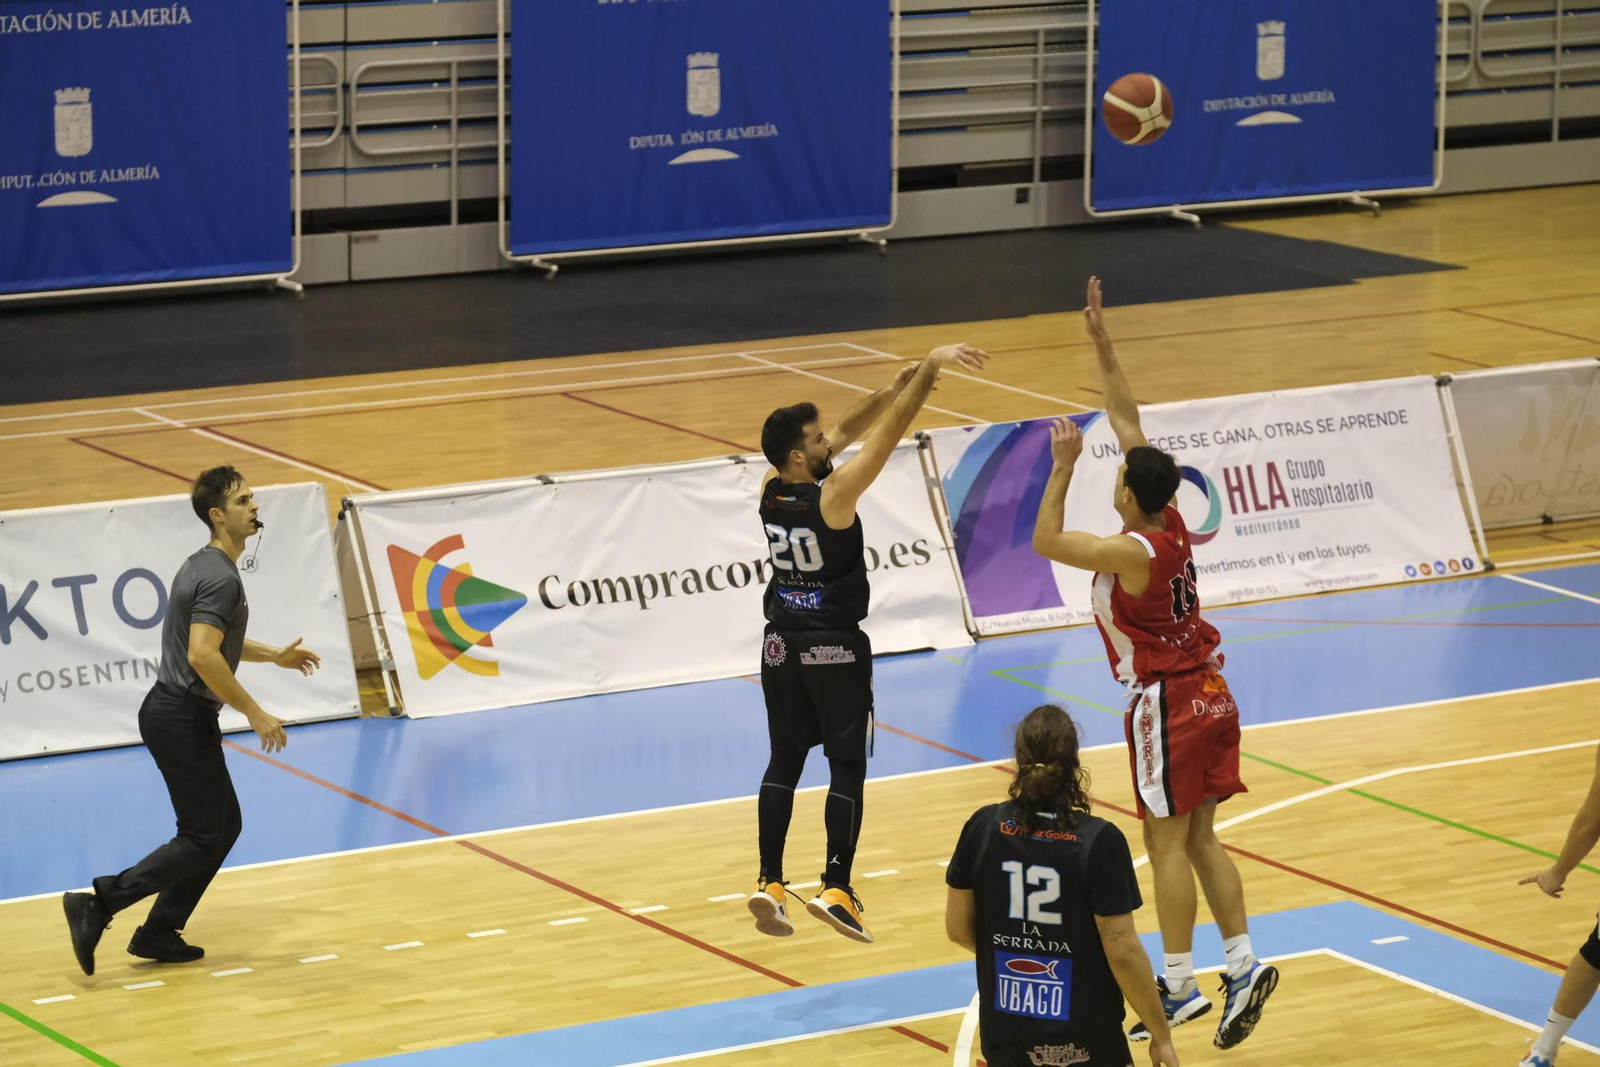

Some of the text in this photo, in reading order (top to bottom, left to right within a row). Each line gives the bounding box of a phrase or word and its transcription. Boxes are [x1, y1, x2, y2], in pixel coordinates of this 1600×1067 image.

[77, 12, 102, 30] DE
[107, 3, 192, 28] ALMERÍA
[629, 130, 705, 149] DIPUTAIÓN
[706, 129, 722, 142] DE
[80, 170, 97, 184] DE
[100, 164, 160, 182] ALMERÍA
[1091, 409, 1410, 460] UN ECES SE GANA, OTRAS SE APRENDE
[1286, 459, 1326, 480] Grupo
[1223, 462, 1290, 515] HLA
[1292, 479, 1374, 507] Hospitalario
[1234, 518, 1301, 536] Mediterráneo
[765, 523, 825, 572] 20
[1195, 542, 1372, 575] nvertimos en ti y en los tuyos
[0, 567, 168, 645] KTO
[17, 657, 160, 693] COSENTIN
[1045, 829, 1077, 842] Galán
[1002, 860, 1062, 925] 12
[1022, 922, 1042, 937] LA
[999, 977, 1063, 1017] UBAGO
